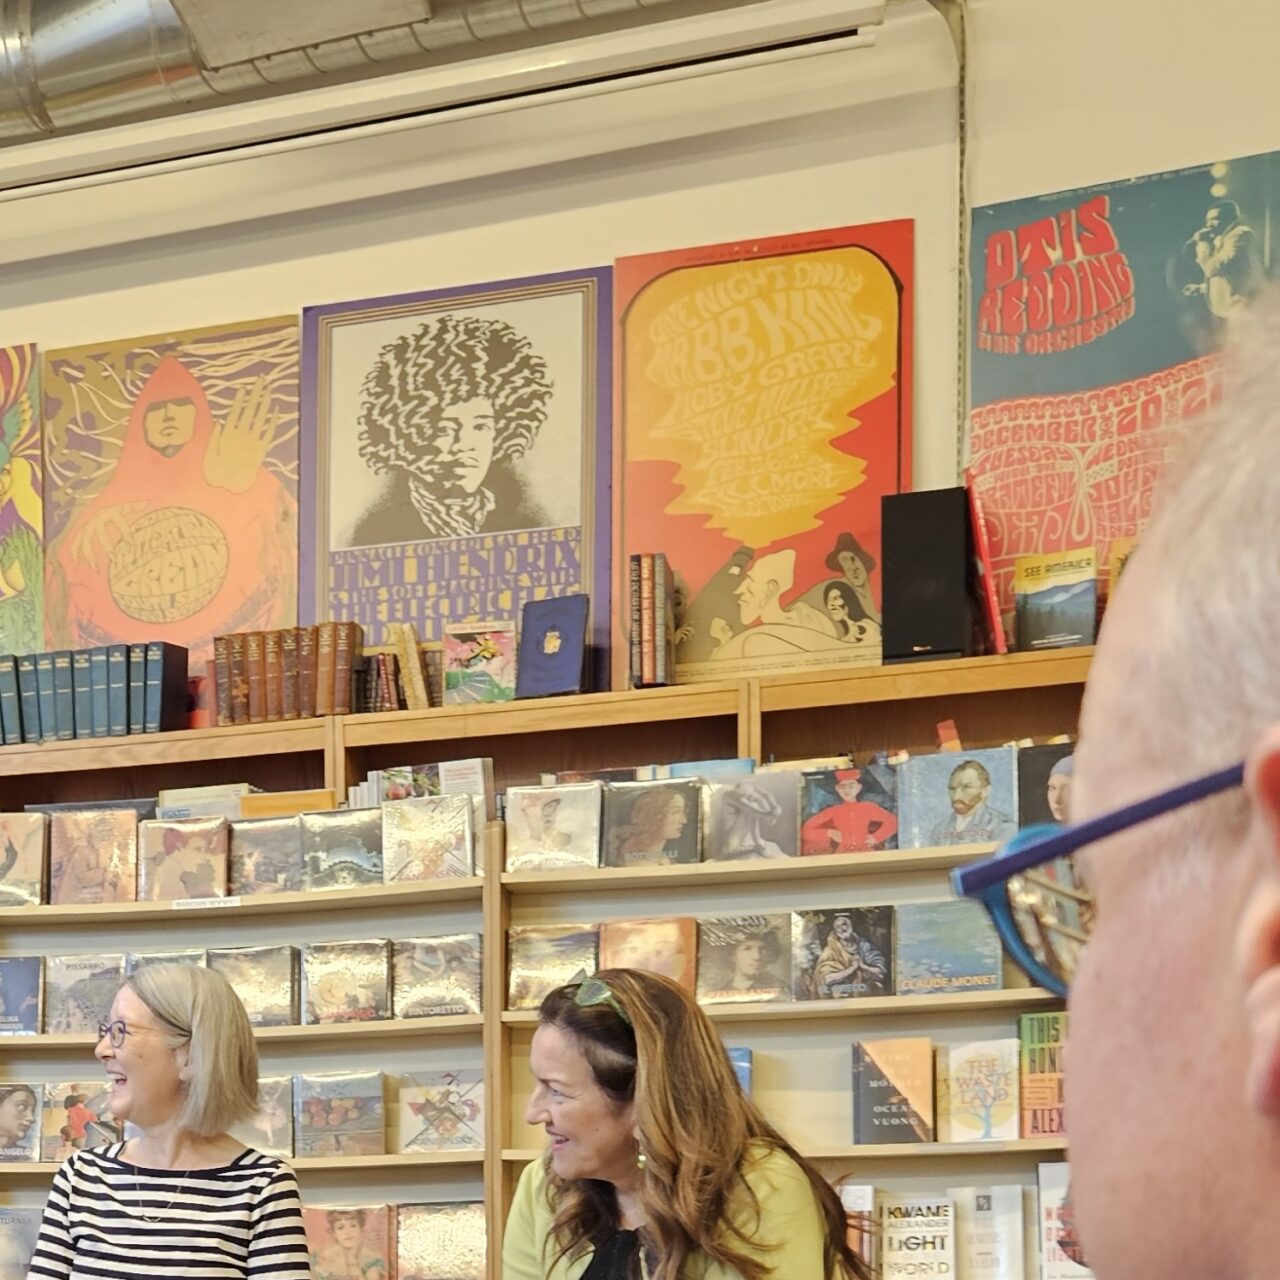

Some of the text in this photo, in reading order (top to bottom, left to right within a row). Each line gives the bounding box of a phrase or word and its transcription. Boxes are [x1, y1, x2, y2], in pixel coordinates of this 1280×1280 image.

[985, 195, 1119, 289] OTIS
[977, 252, 1136, 337] REDDING
[649, 297, 699, 345] ONE
[693, 264, 788, 320] NIGHT
[752, 288, 883, 360] KING
[757, 339, 878, 387] GRAPE
[970, 413, 1098, 453] DECEMBER
[1115, 392, 1163, 436] 20
[329, 541, 582, 590] JIMI HENDRIX
[1024, 564, 1043, 579] SEE
[1044, 557, 1093, 575] AMERICA
[65, 963, 106, 971] PISSARRO
[901, 973, 998, 989] CLAUDE MONET
[407, 1004, 466, 1016] TINTORETTO
[1027, 1015, 1061, 1044] THIS
[966, 1057, 999, 1071] THE
[955, 1071, 1013, 1090] WASTE
[960, 1087, 1009, 1106] LAND
[872, 1117, 920, 1126] VUONG
[887, 1205, 950, 1218] KWAME
[0, 1217, 33, 1226] TURNER
[887, 1218, 950, 1229] ALEXANDER
[888, 1262, 950, 1276] WORLD
